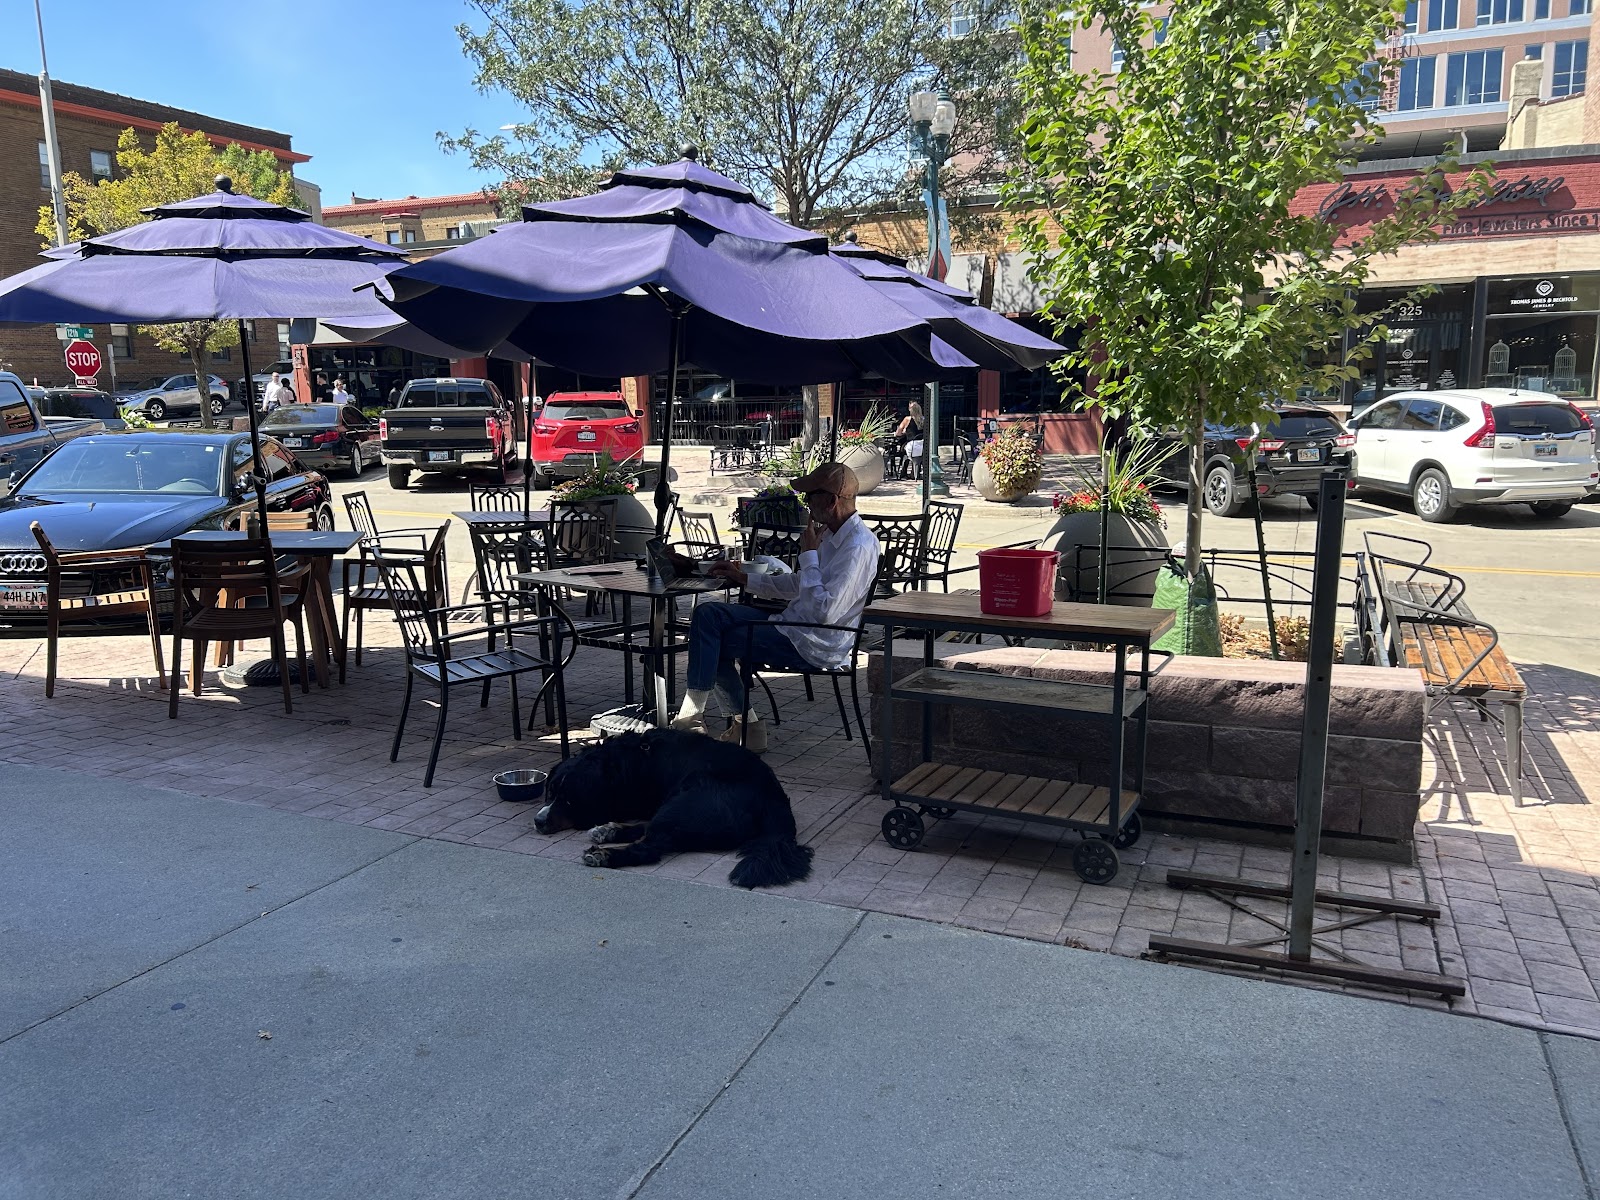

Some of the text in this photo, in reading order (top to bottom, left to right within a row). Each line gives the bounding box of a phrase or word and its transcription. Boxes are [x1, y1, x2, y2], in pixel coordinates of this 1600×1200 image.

[1548, 213, 1589, 228] Since
[1399, 305, 1423, 316] 325
[67, 328, 79, 338] 12th
[68, 352, 98, 367] STOP
